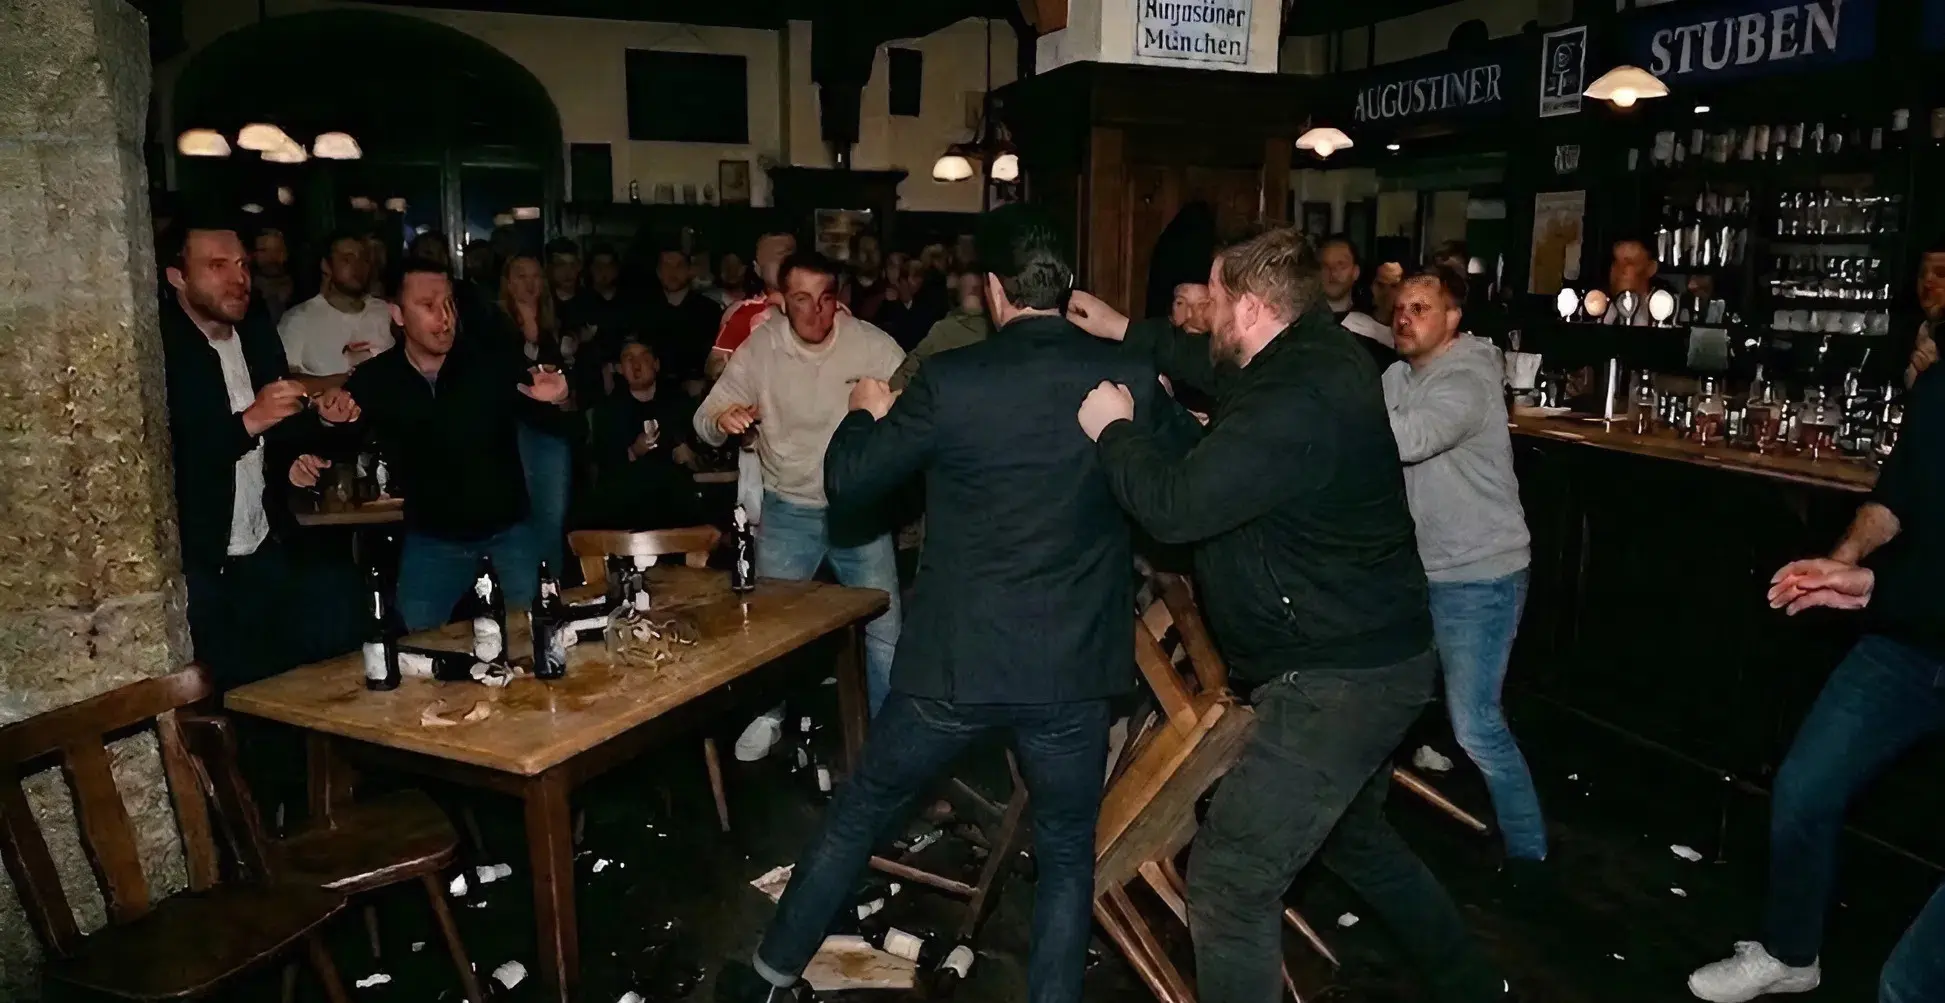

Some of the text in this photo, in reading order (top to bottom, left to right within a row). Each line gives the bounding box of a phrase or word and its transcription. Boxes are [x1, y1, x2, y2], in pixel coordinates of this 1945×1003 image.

[1144, 27, 1241, 56] München
[1650, 0, 1842, 76] STUBEN
[1354, 64, 1501, 122] AUGUSTINER
